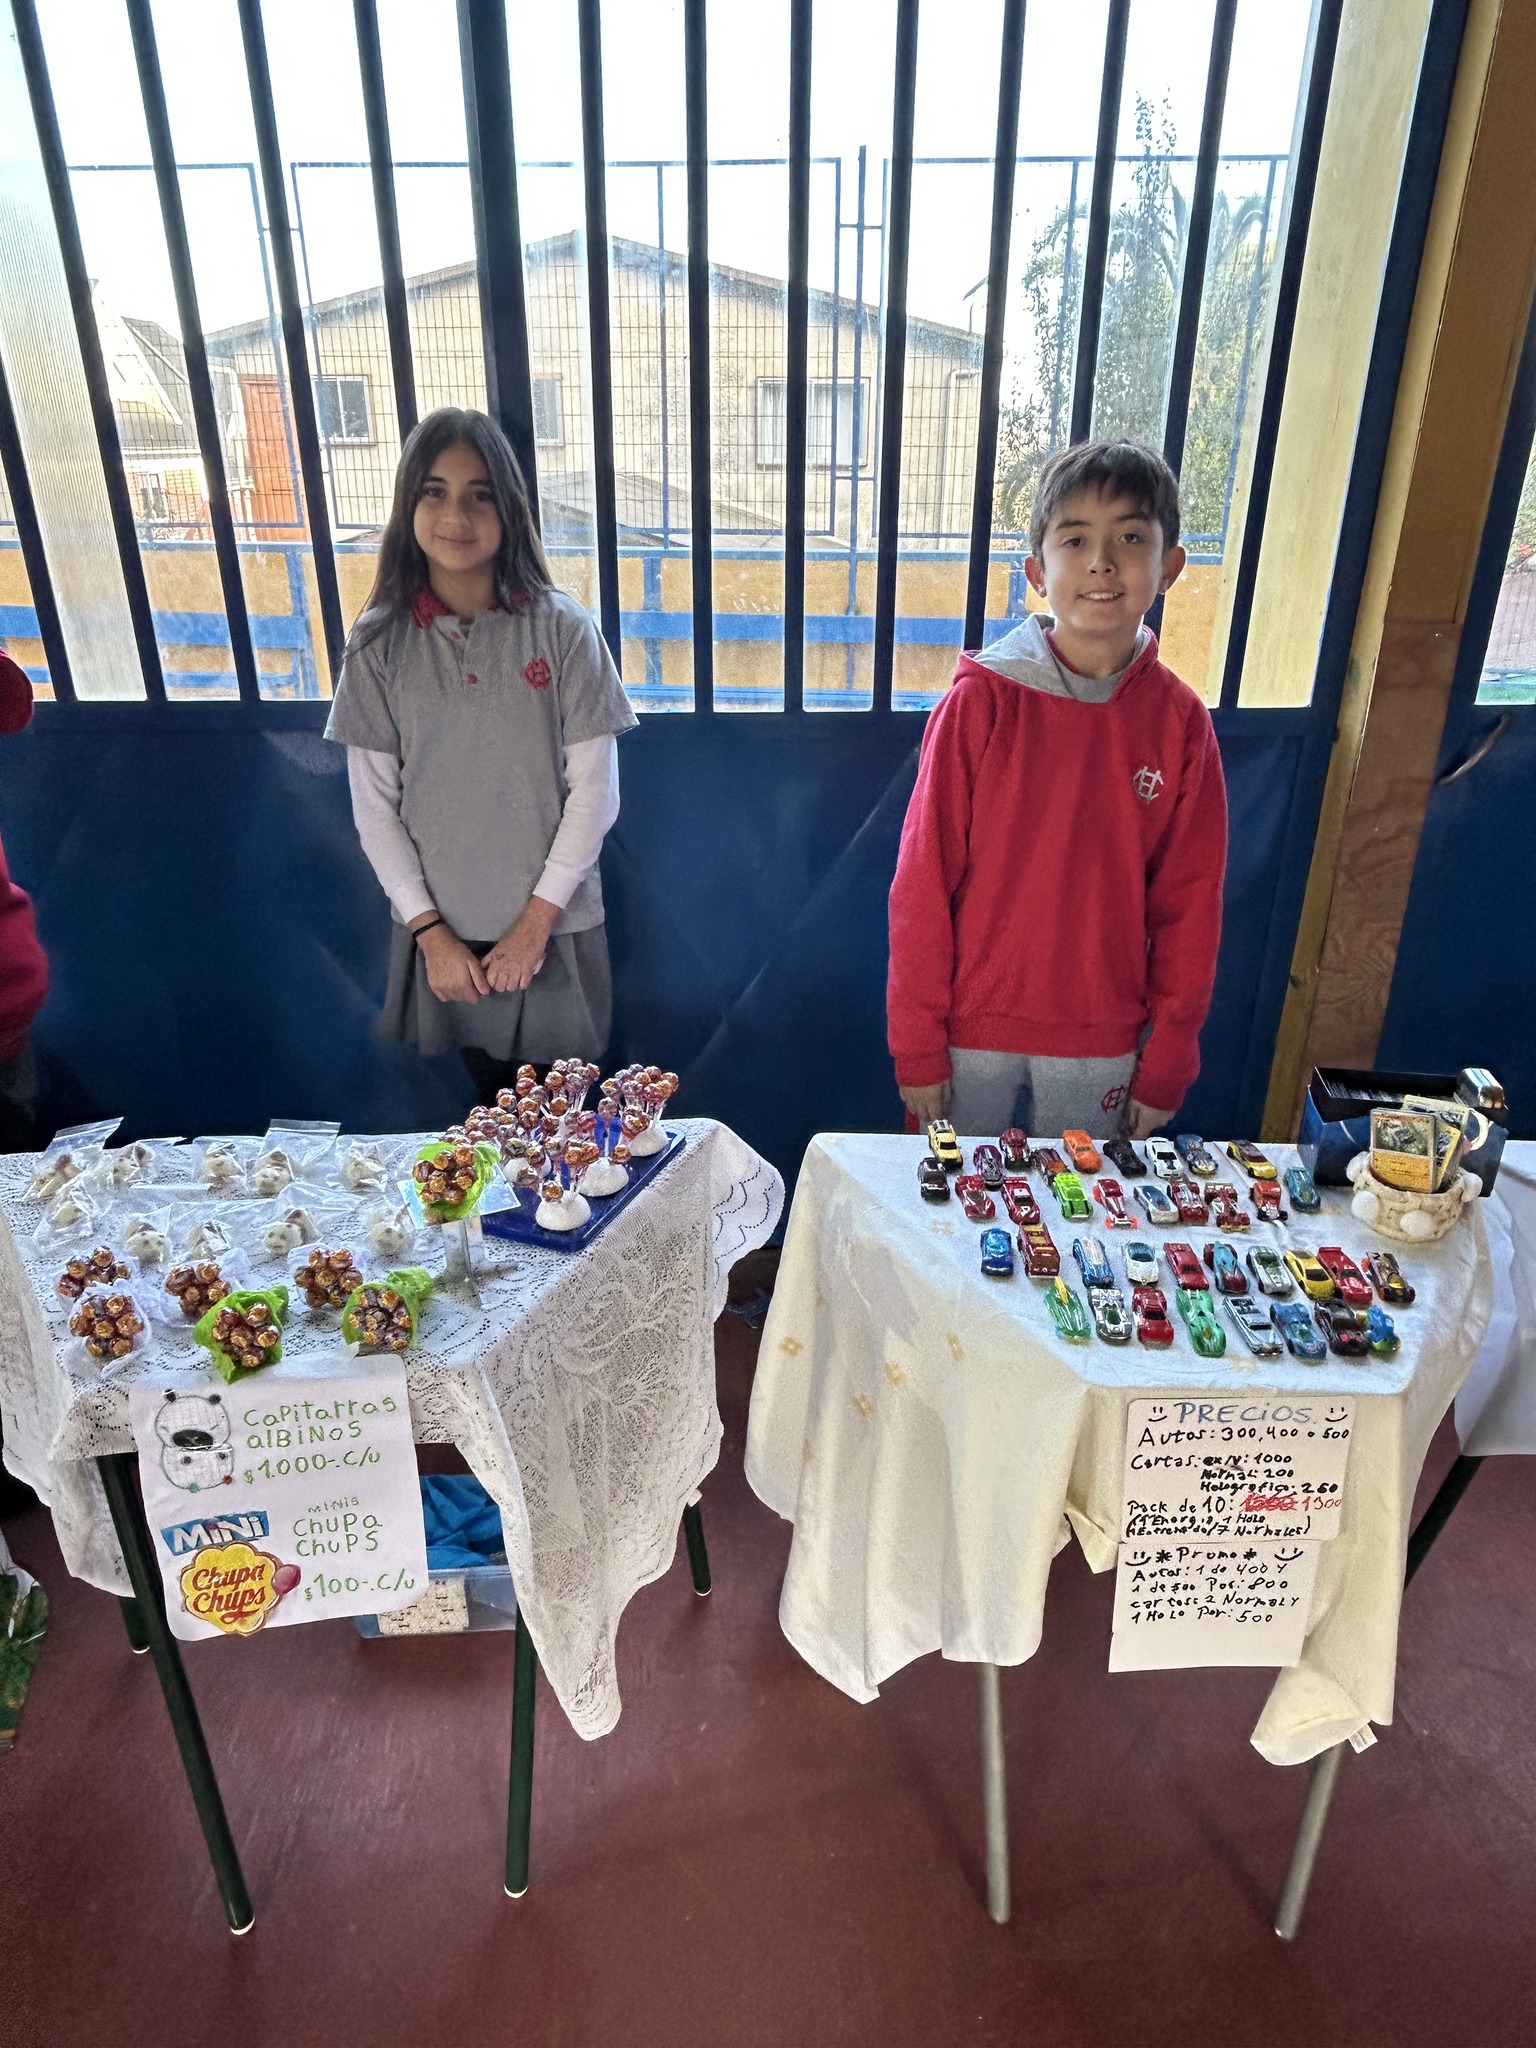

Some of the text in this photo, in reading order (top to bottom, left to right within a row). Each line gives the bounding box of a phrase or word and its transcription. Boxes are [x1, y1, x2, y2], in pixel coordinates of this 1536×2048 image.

[1137, 1427, 1215, 1447] Autos:
[1221, 1427, 1263, 1441] 300,
[1267, 1426, 1298, 1439] 400
[1322, 1427, 1349, 1439] 500
[1254, 1452, 1292, 1464] 1000
[1264, 1469, 1294, 1478] 200
[1179, 1498, 1197, 1512] de
[1202, 1495, 1234, 1513] 10:
[1302, 1496, 1342, 1511] 1300
[192, 1564, 265, 1591] Chupa
[1132, 1566, 1190, 1582] Autos:
[1196, 1565, 1205, 1575] 1
[1236, 1562, 1268, 1575] 400
[1150, 1581, 1166, 1593] de
[1170, 1583, 1196, 1594] 500
[1248, 1577, 1288, 1590] 800
[193, 1586, 266, 1624] Chups
[1205, 1595, 1216, 1604] 2
[1131, 1611, 1141, 1624] 1
[1235, 1610, 1272, 1622] 500
